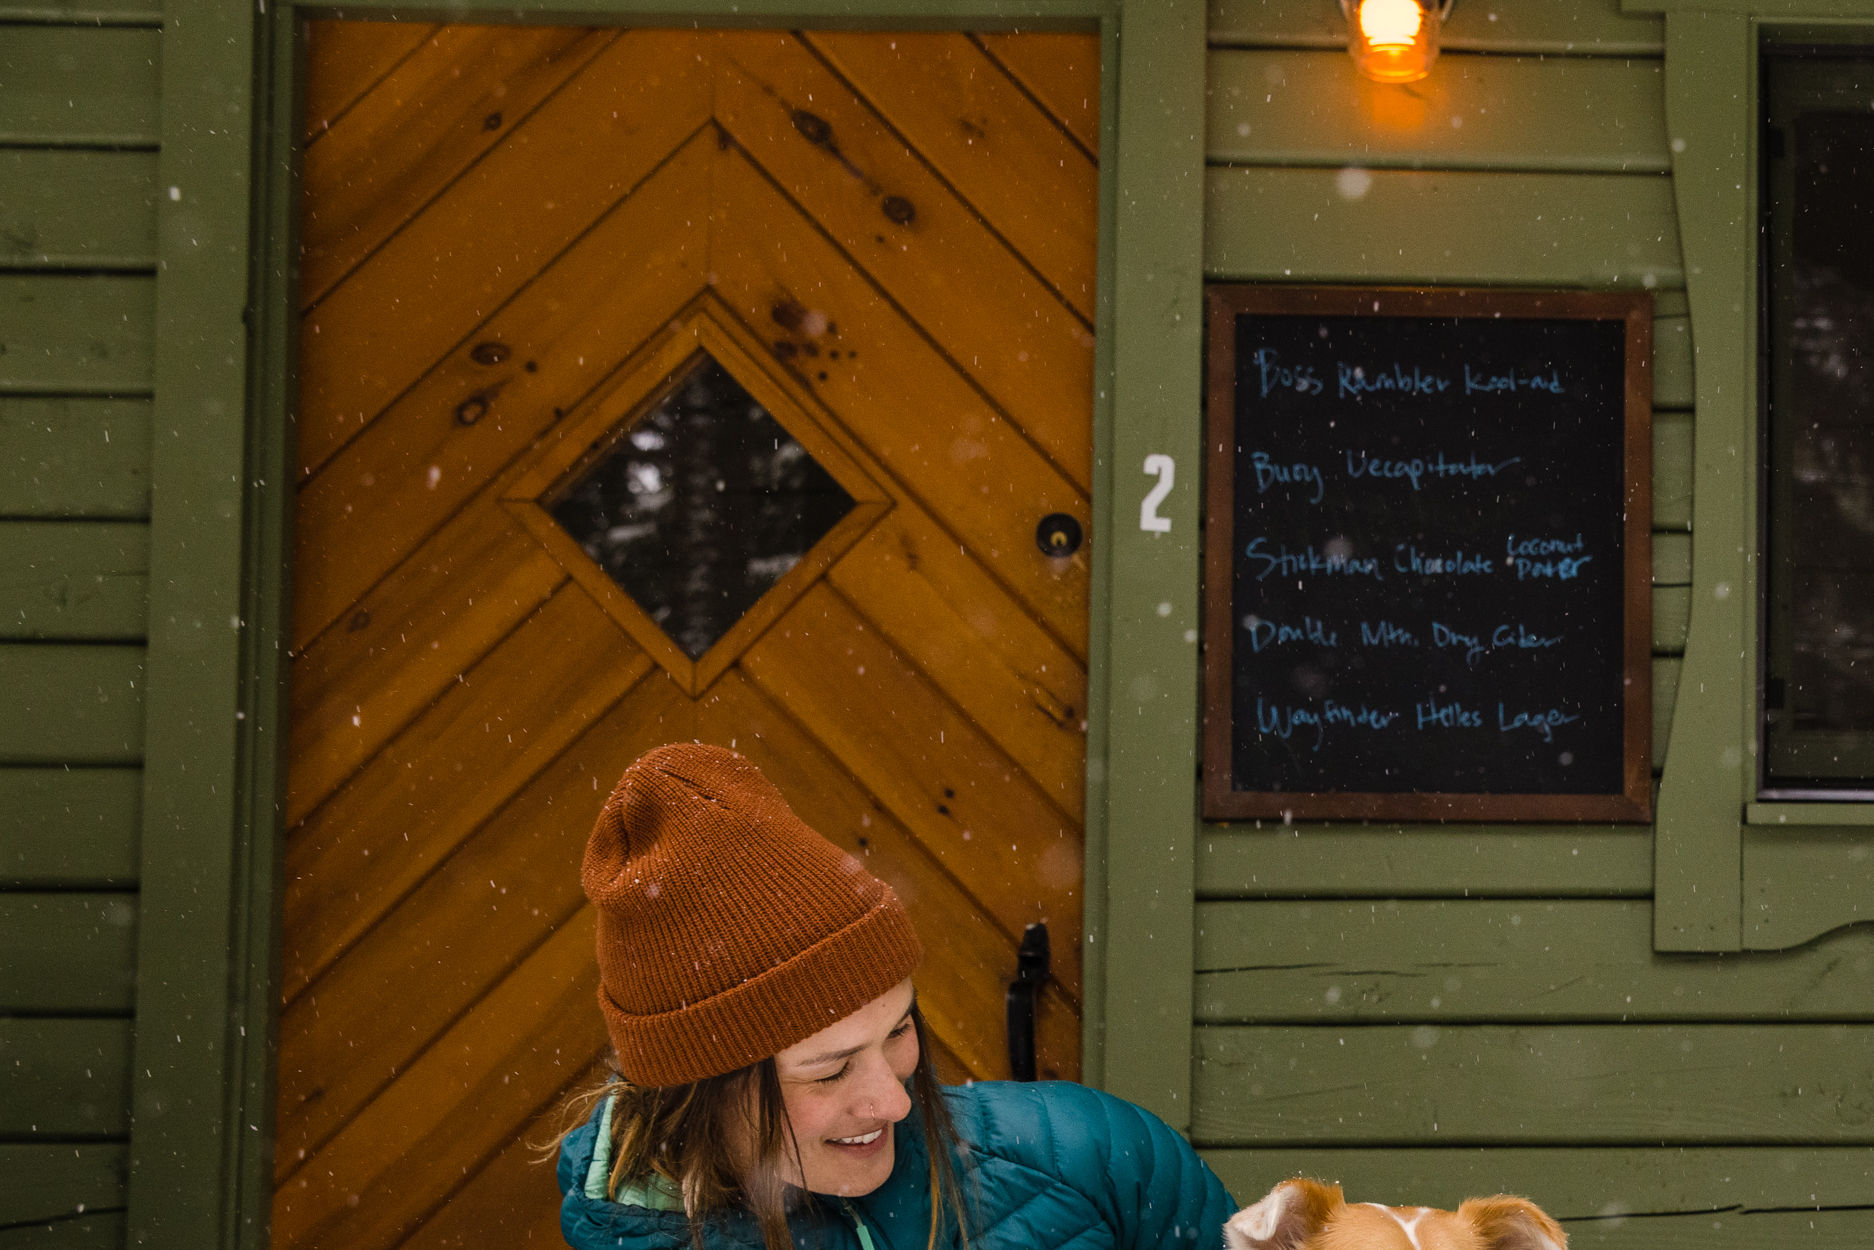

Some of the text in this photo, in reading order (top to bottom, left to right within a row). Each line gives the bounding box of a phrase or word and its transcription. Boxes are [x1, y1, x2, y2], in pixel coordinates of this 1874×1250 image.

[1254, 348, 1323, 398] Boss
[1337, 361, 1451, 399] Rambler
[1140, 454, 1175, 532] 2
[1251, 451, 1324, 504] Buoy
[1393, 543, 1494, 576] Chocolate
[1506, 532, 1585, 556] Coconut
[1431, 621, 1485, 666] Dry
[1416, 696, 1484, 731] Helles
[1499, 701, 1581, 742] Lager
